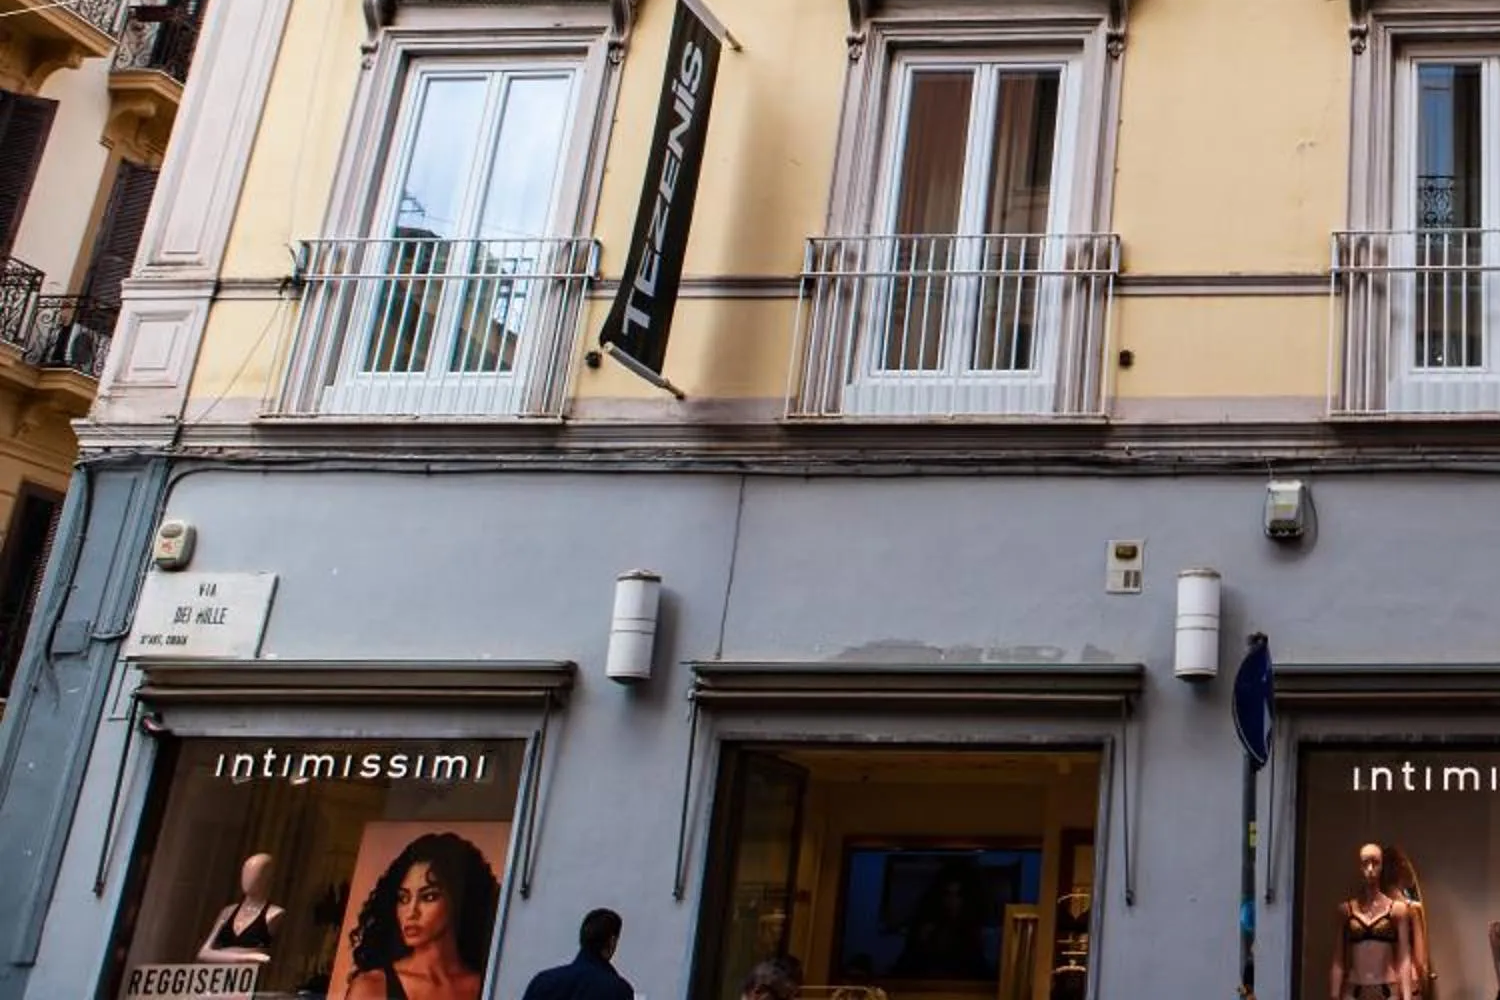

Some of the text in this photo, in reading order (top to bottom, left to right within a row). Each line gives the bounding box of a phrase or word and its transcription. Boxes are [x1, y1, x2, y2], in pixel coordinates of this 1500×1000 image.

[199, 583, 217, 597] VIA
[173, 605, 228, 625] DEI MILLE
[214, 747, 486, 778] intimissimi
[127, 967, 254, 995] REGGISENO
